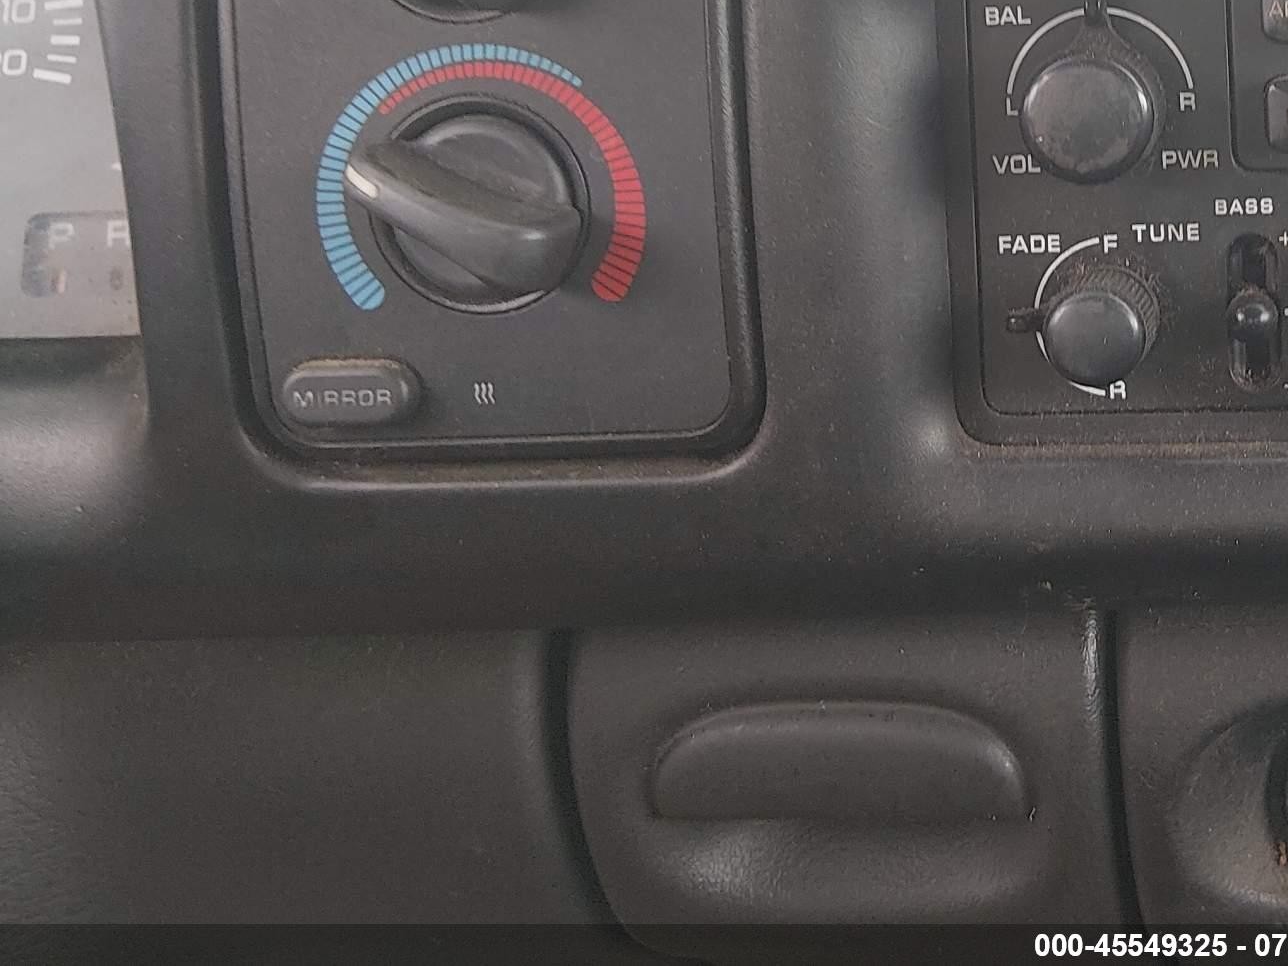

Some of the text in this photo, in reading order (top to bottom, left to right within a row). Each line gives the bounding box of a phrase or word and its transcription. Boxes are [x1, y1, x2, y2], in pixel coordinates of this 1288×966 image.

[985, 6, 1031, 26] BAL
[1006, 94, 1019, 116] L
[1179, 92, 1196, 112] R
[993, 154, 1041, 175] VOL
[1162, 150, 1219, 170] PWR
[1214, 199, 1274, 216] BASS
[1132, 223, 1200, 242] TUNE
[999, 235, 1061, 253] FADE
[1103, 234, 1119, 253] F
[293, 390, 392, 408] MIRROR
[1110, 381, 1127, 399] R
